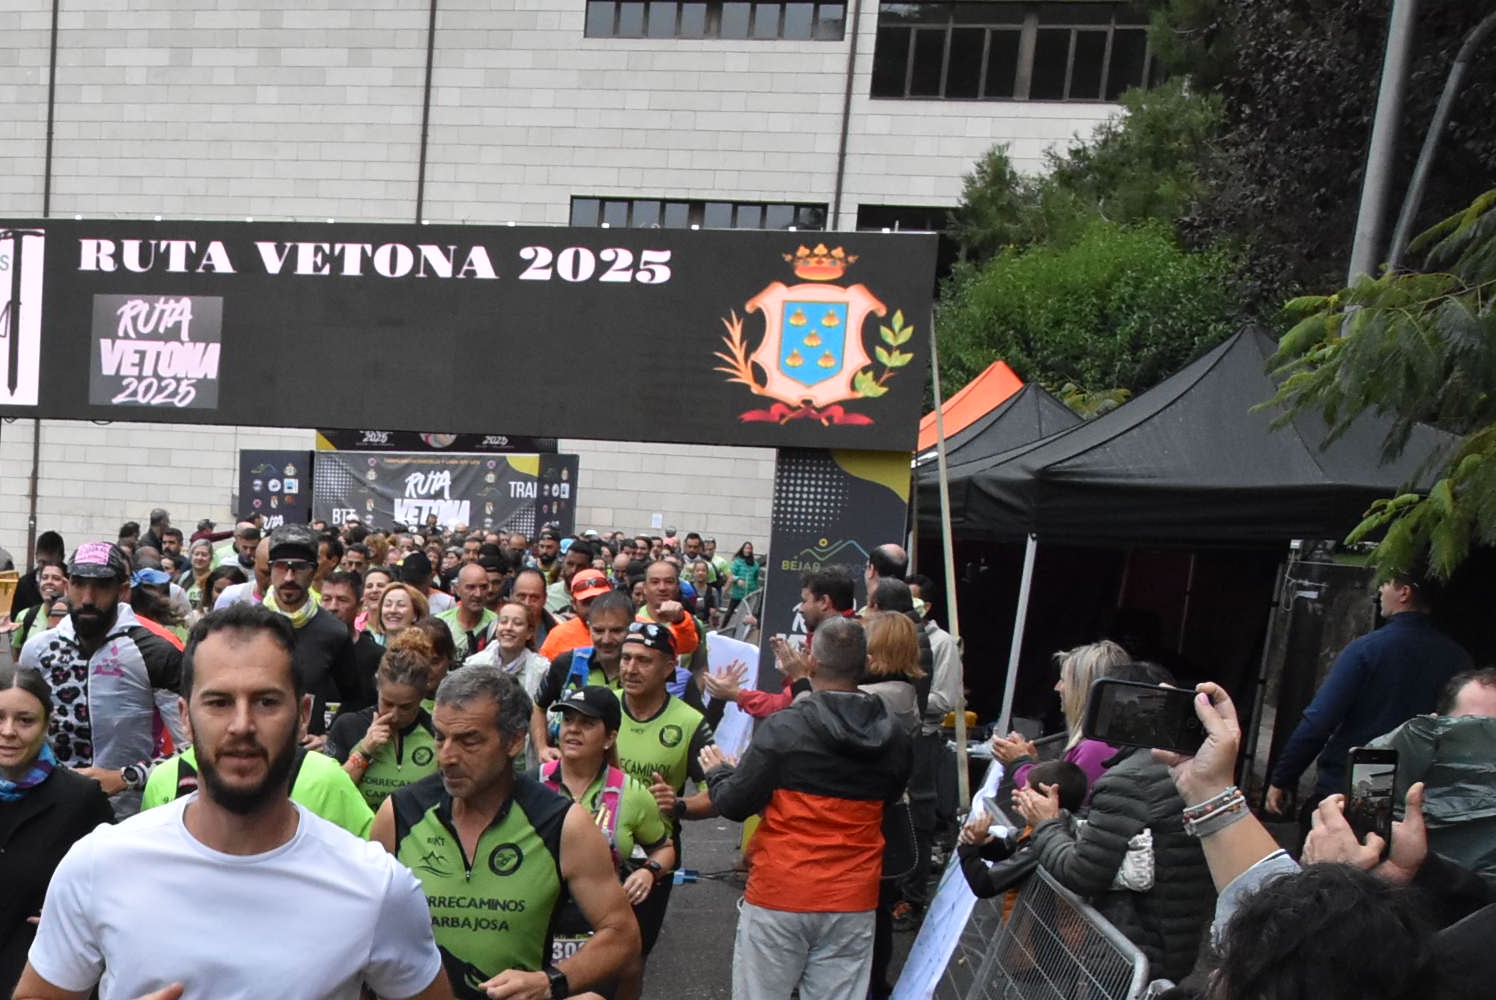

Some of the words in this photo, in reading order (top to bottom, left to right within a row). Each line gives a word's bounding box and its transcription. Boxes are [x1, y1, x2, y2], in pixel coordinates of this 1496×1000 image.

[77, 238, 237, 273] RUTA
[254, 241, 500, 280] VETONA
[518, 246, 672, 284] 2025
[116, 297, 192, 341] RUTA
[99, 338, 221, 379] VETONA
[112, 377, 196, 407] 2025
[405, 470, 451, 500] RUTA
[431, 916, 510, 932] ARBAJOSA
